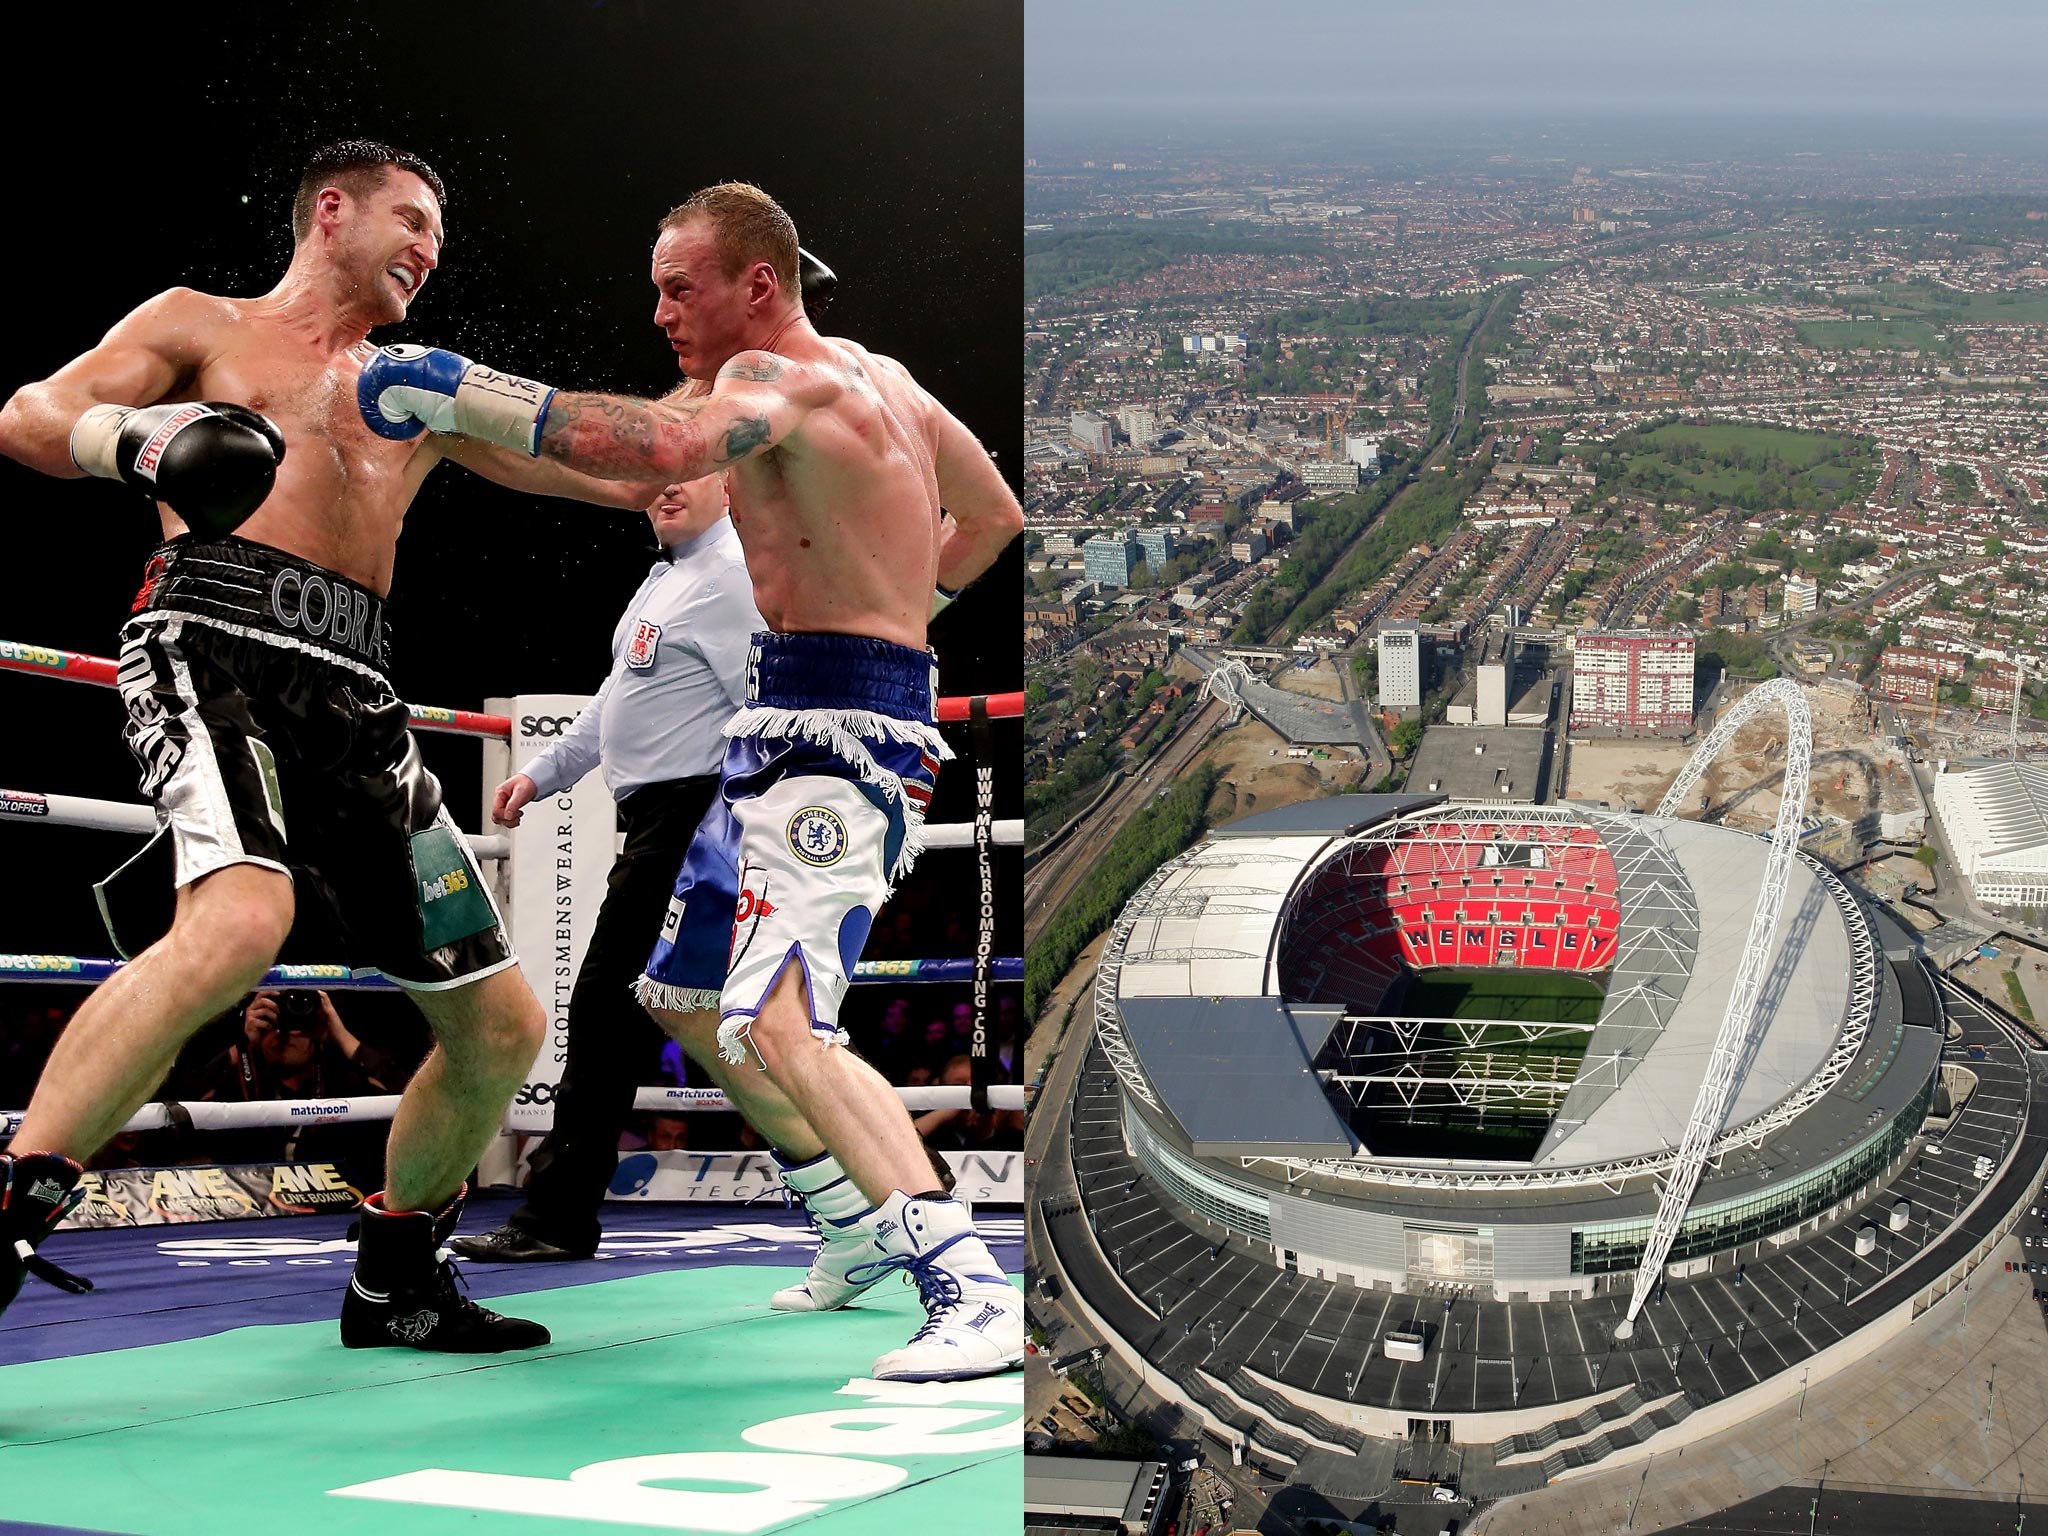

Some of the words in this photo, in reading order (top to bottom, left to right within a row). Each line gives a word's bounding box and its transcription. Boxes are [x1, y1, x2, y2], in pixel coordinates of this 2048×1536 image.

[140, 408, 203, 472] ONSDALE
[271, 567, 384, 667] COBRA
[0, 642, 60, 666] et365
[409, 703, 450, 723] et365
[11, 802, 45, 814] OFFICE
[802, 811, 838, 827] CHELSEA
[422, 868, 469, 903] bet365
[1406, 929, 1609, 952] WEMBLEY
[853, 959, 912, 975] et365
[291, 1105, 349, 1116] matchroom
[281, 1194, 309, 1205] LIVE
[307, 1191, 354, 1204] BOXING
